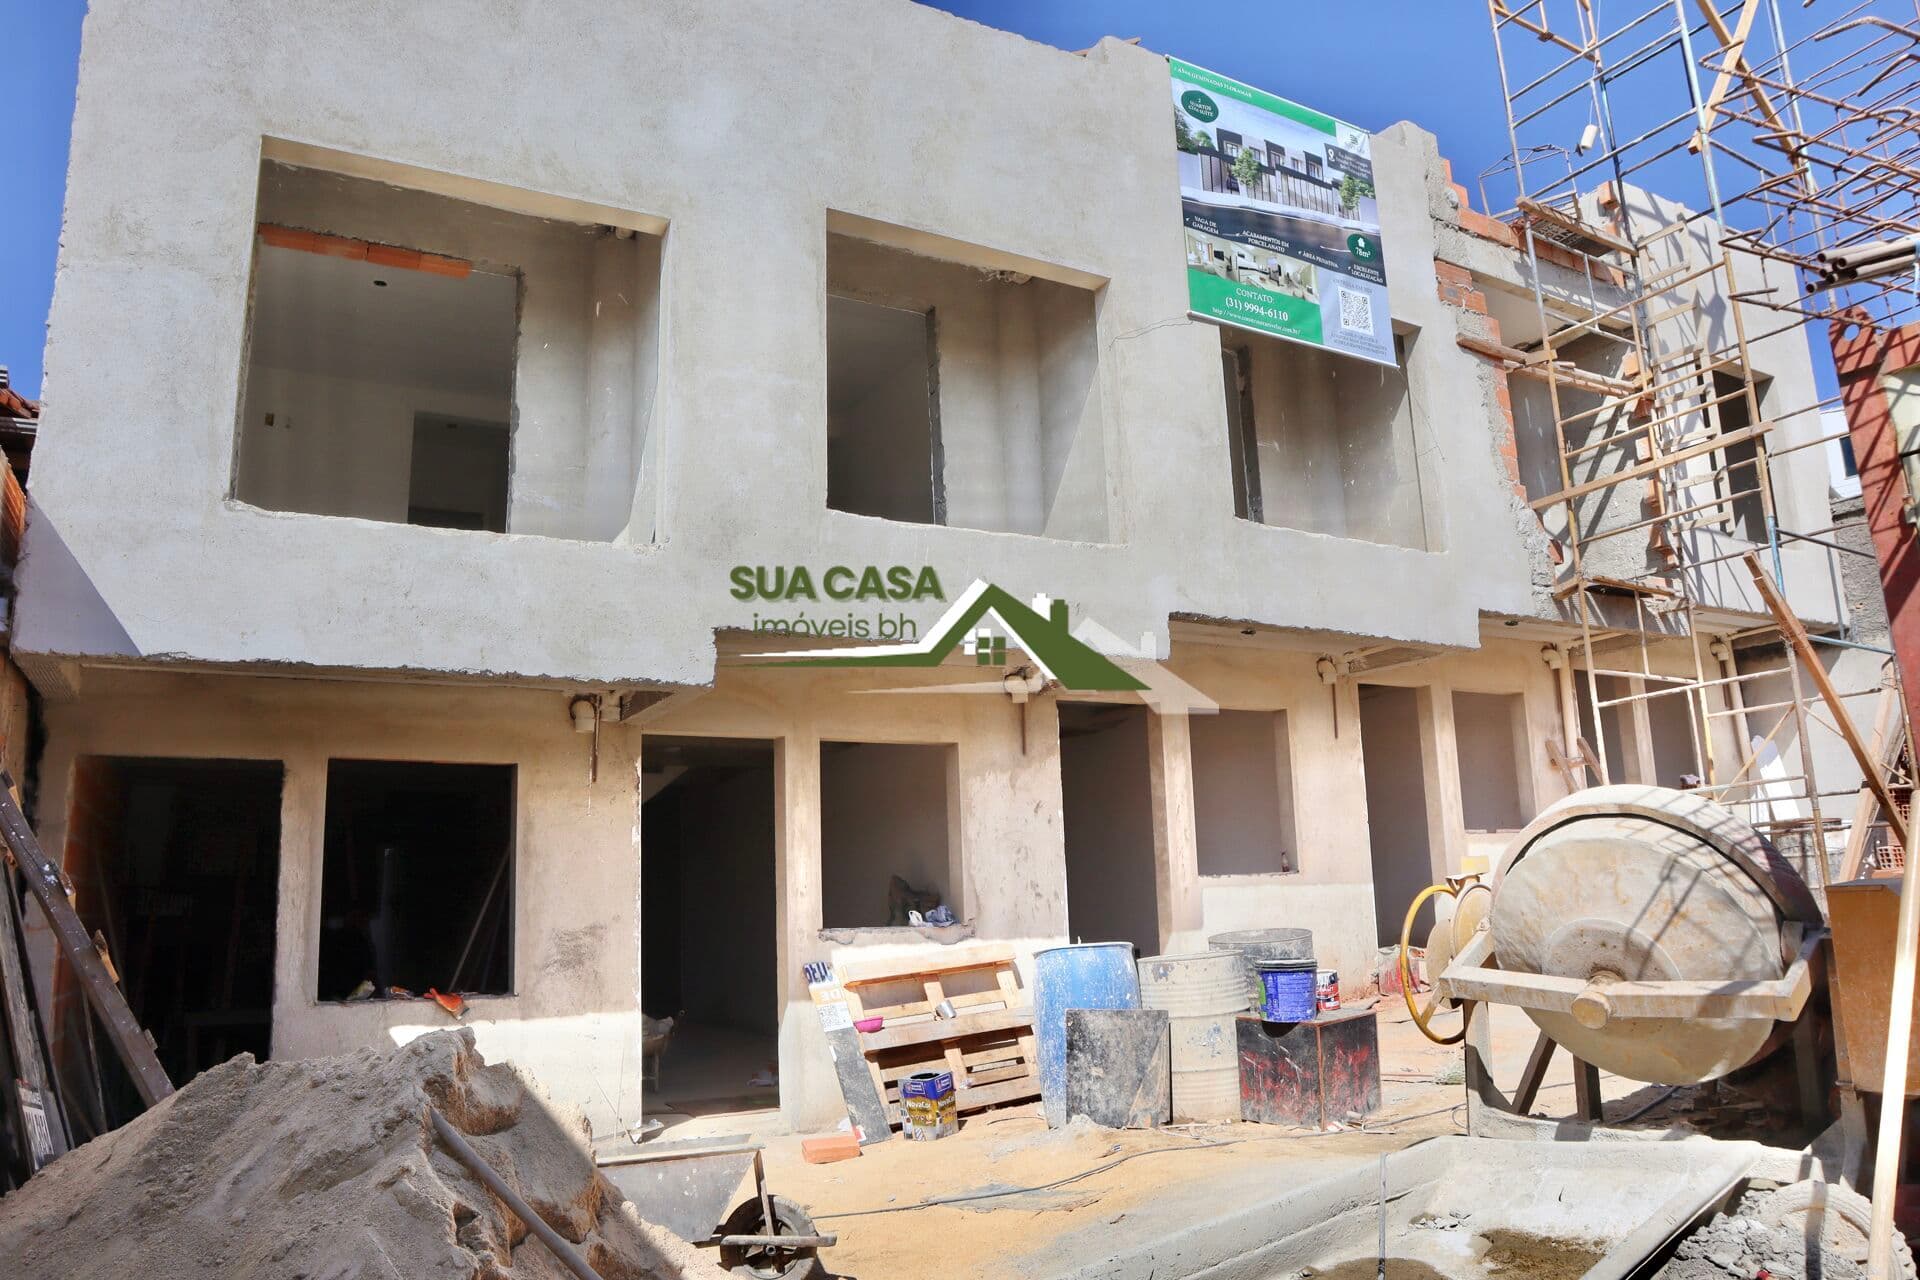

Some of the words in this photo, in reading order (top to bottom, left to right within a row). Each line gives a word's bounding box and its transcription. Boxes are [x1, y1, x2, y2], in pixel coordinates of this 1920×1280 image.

[1192, 222, 1219, 235] GARAGEM
[1194, 215, 1209, 226] VAGA
[1209, 220, 1217, 228] DE
[1242, 230, 1281, 246] ACABAMENTOS
[1280, 240, 1290, 248] EM
[1247, 237, 1285, 253] PORCELANATO
[1225, 296, 1242, 311] (31)
[1244, 301, 1289, 322] 9994-6110
